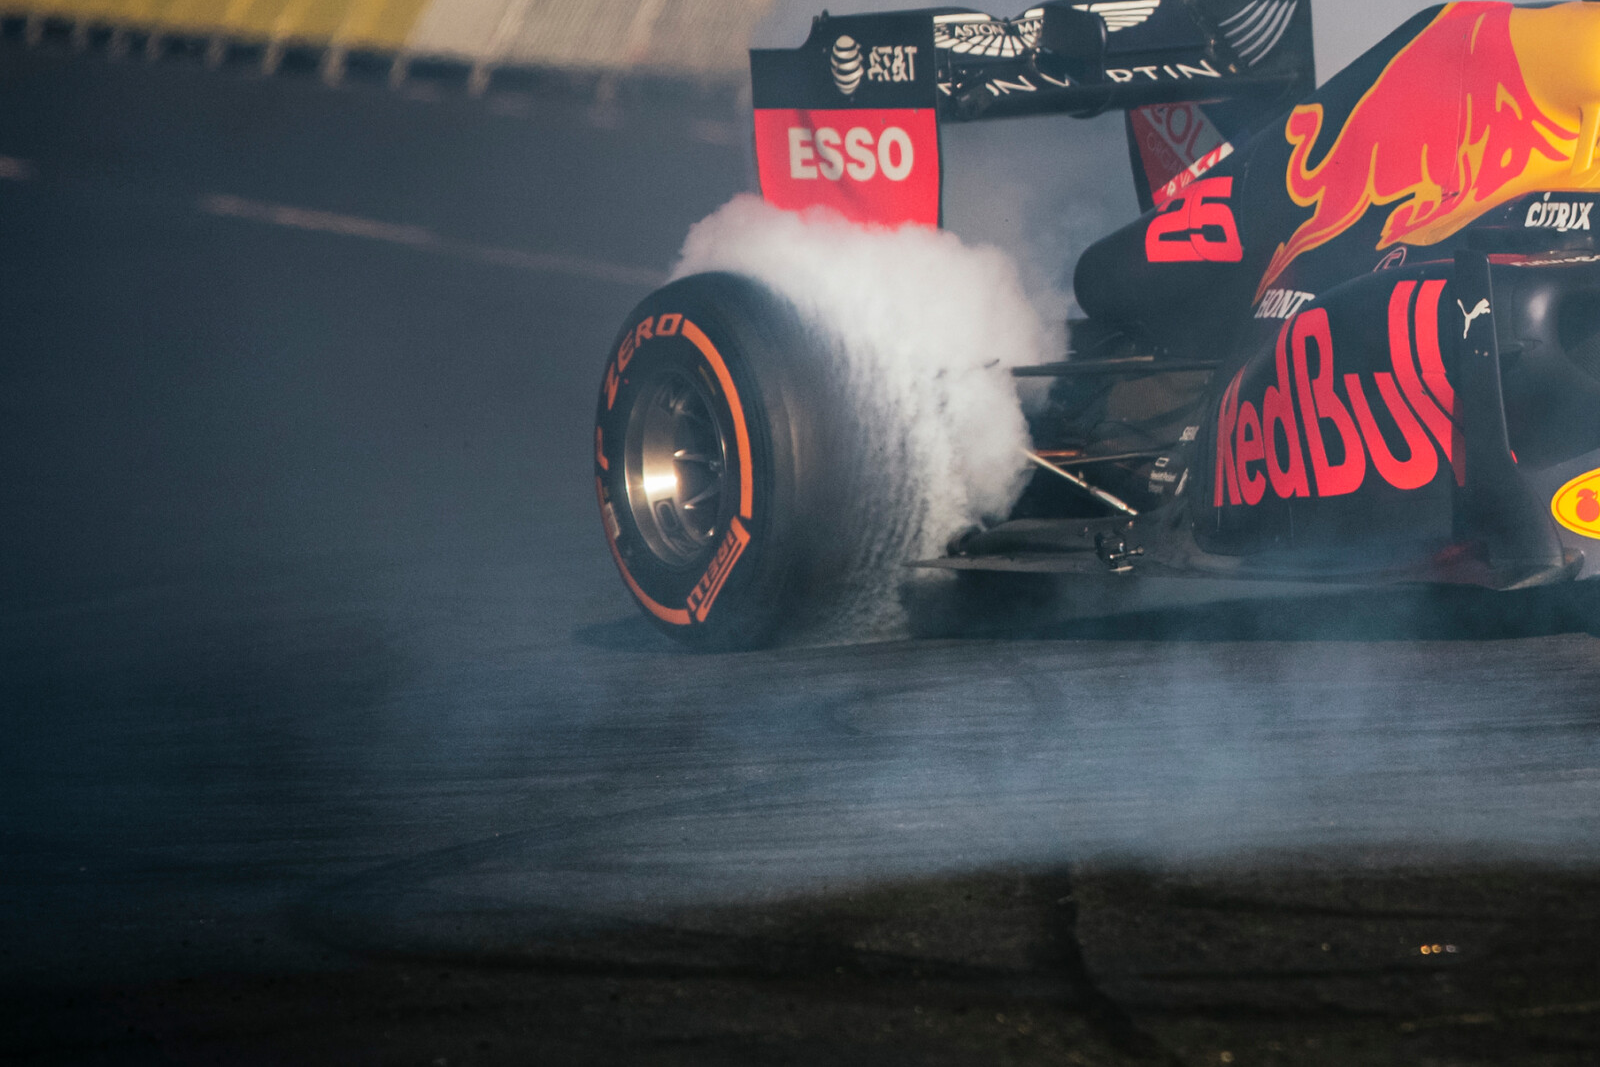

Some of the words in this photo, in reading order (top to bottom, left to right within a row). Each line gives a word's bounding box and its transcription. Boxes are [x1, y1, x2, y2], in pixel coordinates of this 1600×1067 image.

[954, 22, 1004, 37] ASTON
[866, 45, 918, 82] AT&T
[788, 126, 914, 182] ESSO
[603, 313, 683, 411] ZERO
[686, 515, 751, 622] PIRELLI
